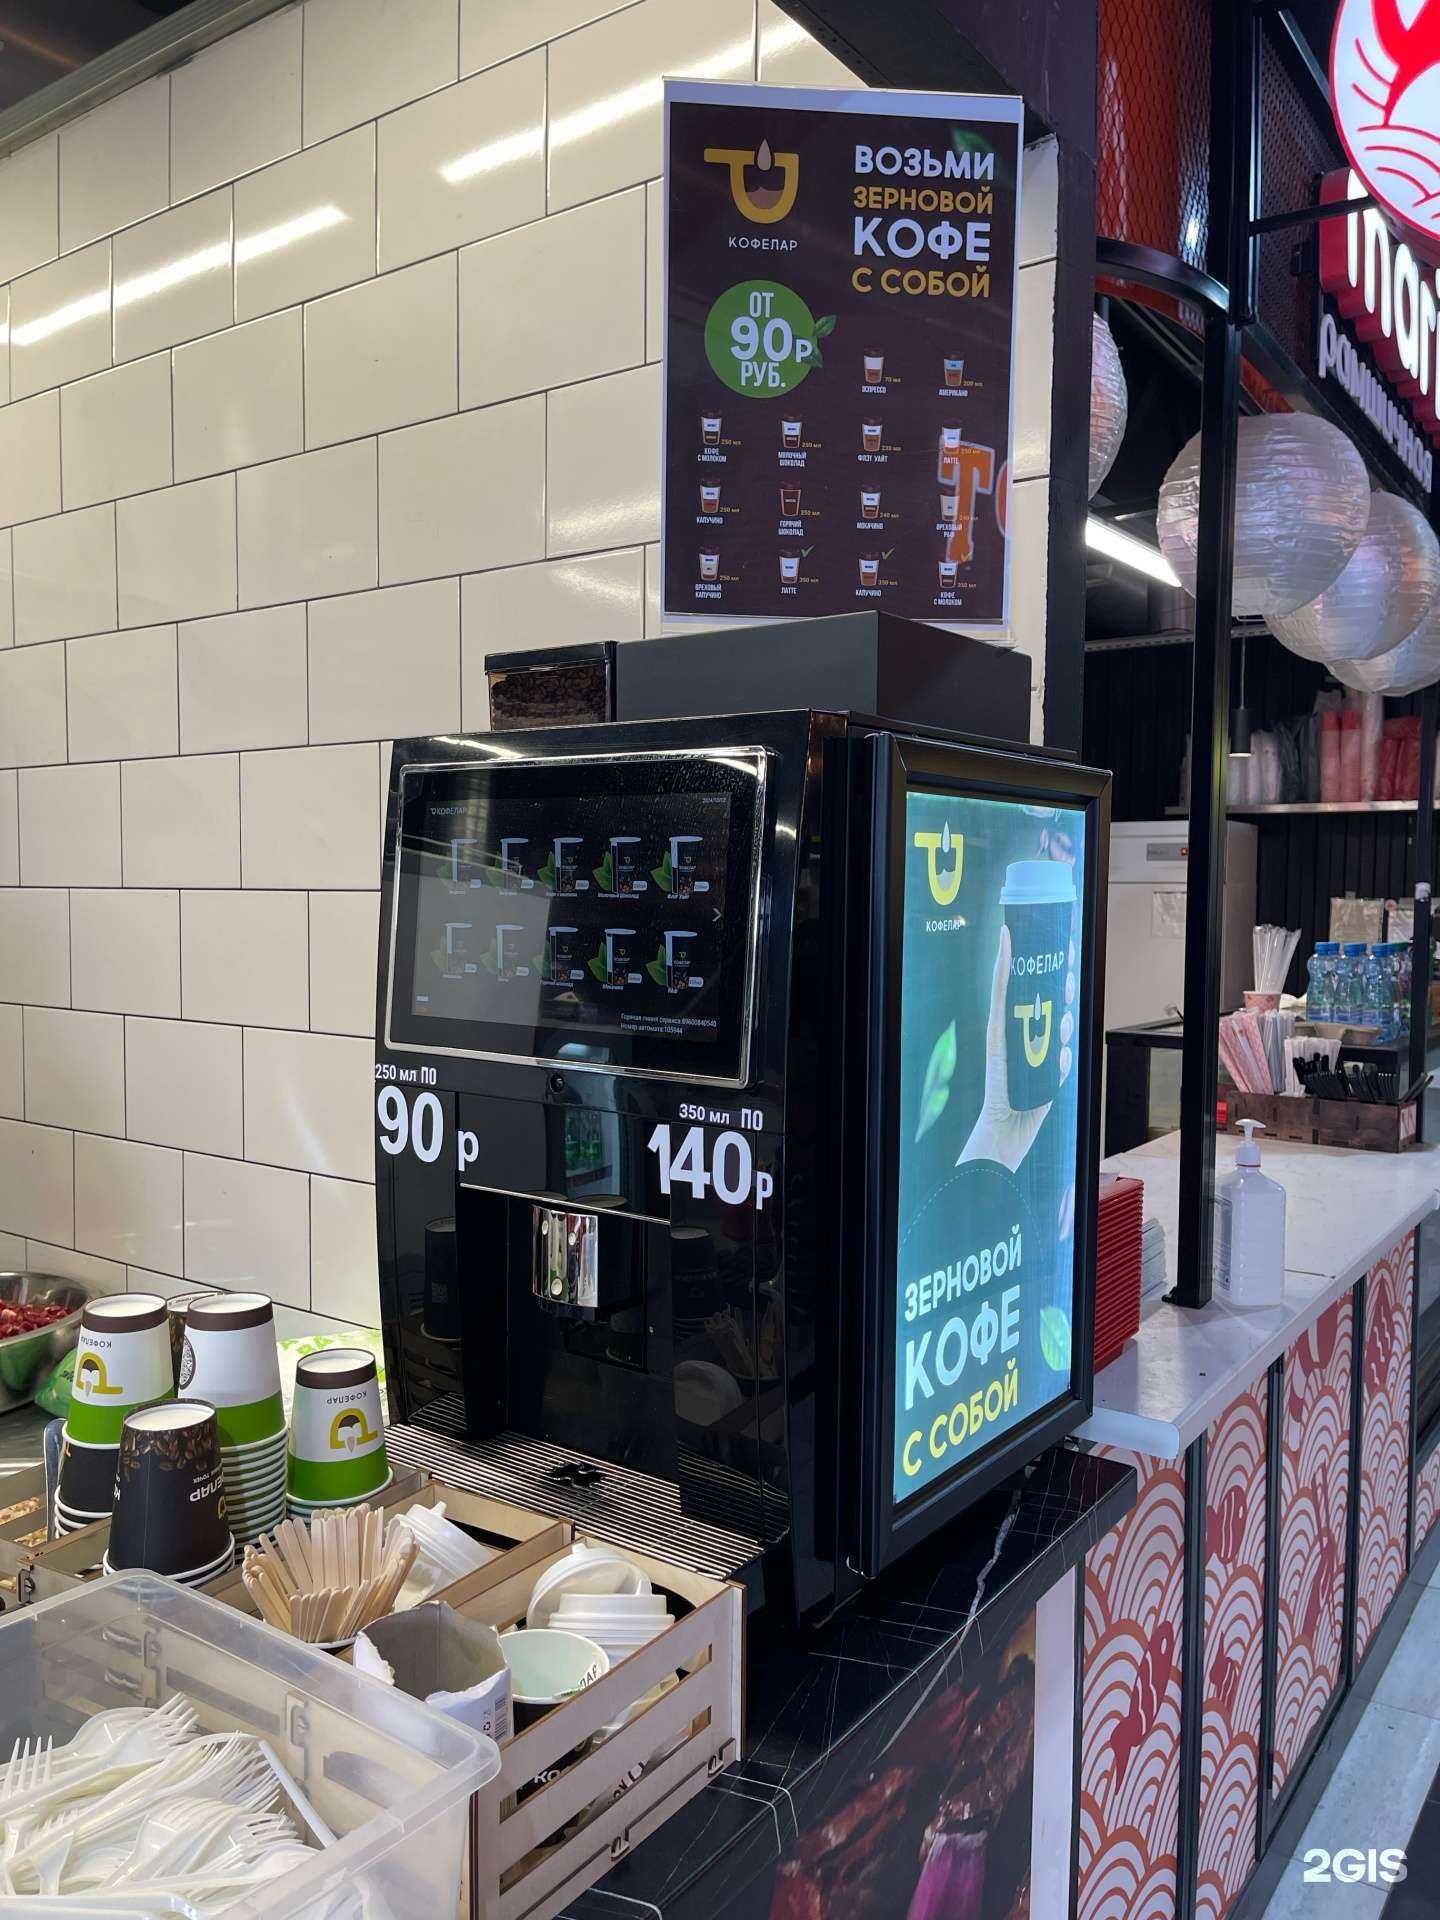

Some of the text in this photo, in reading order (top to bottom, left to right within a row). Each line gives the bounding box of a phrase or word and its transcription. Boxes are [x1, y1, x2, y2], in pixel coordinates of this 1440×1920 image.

[855, 145, 994, 181] ВОЗЬМИ
[853, 186, 993, 214] ЗЕРНОВОЙ
[728, 236, 798, 251] КОФЕЛАР
[853, 216, 991, 261] КОФЕ
[852, 265, 990, 298] С СОБОЙ
[749, 291, 774, 318] ОТ
[740, 361, 786, 388] РУБ.
[926, 919, 962, 932] КОФЕЛАР
[1011, 951, 1065, 977] КОФЕЛАР
[375, 1064, 437, 1086] 250 мл ПО
[377, 1086, 444, 1163] 90
[679, 1104, 763, 1131] 350 мл ПО
[905, 1223, 1022, 1322] ЗЕРНОВОЙ
[905, 1284, 1020, 1410] КОФЕ
[326, 1391, 367, 1405] КОФЕЛАР
[903, 1357, 1018, 1477] С СОБОЙ
